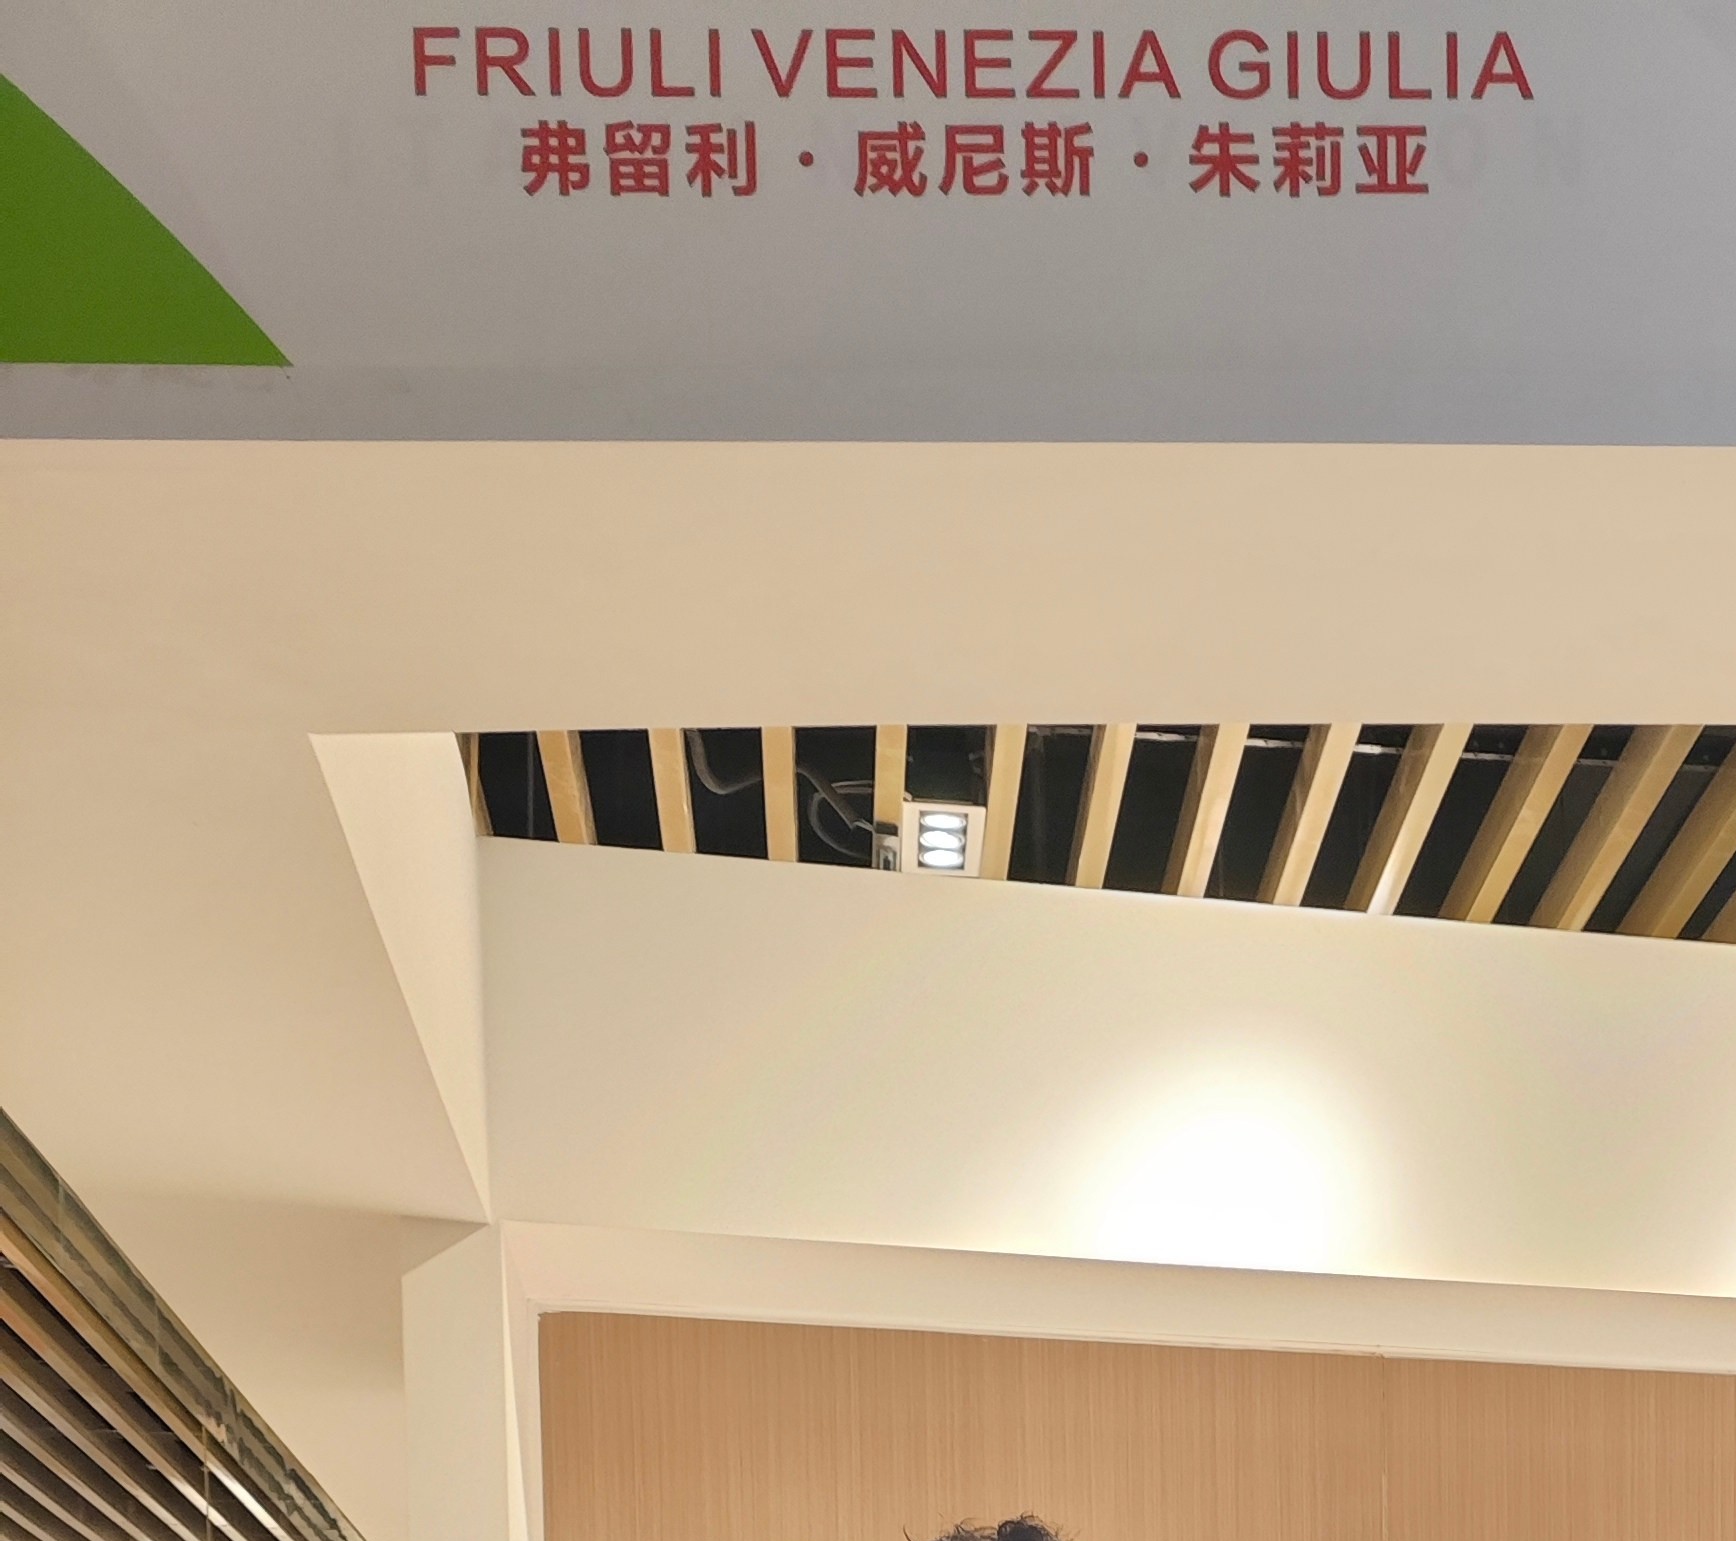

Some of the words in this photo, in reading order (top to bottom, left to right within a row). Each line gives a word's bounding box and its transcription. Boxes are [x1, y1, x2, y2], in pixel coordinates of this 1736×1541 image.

[410, 25, 722, 97] FRIULI
[752, 27, 1181, 100] VENEZIA
[1206, 30, 1535, 102] GIULIA
